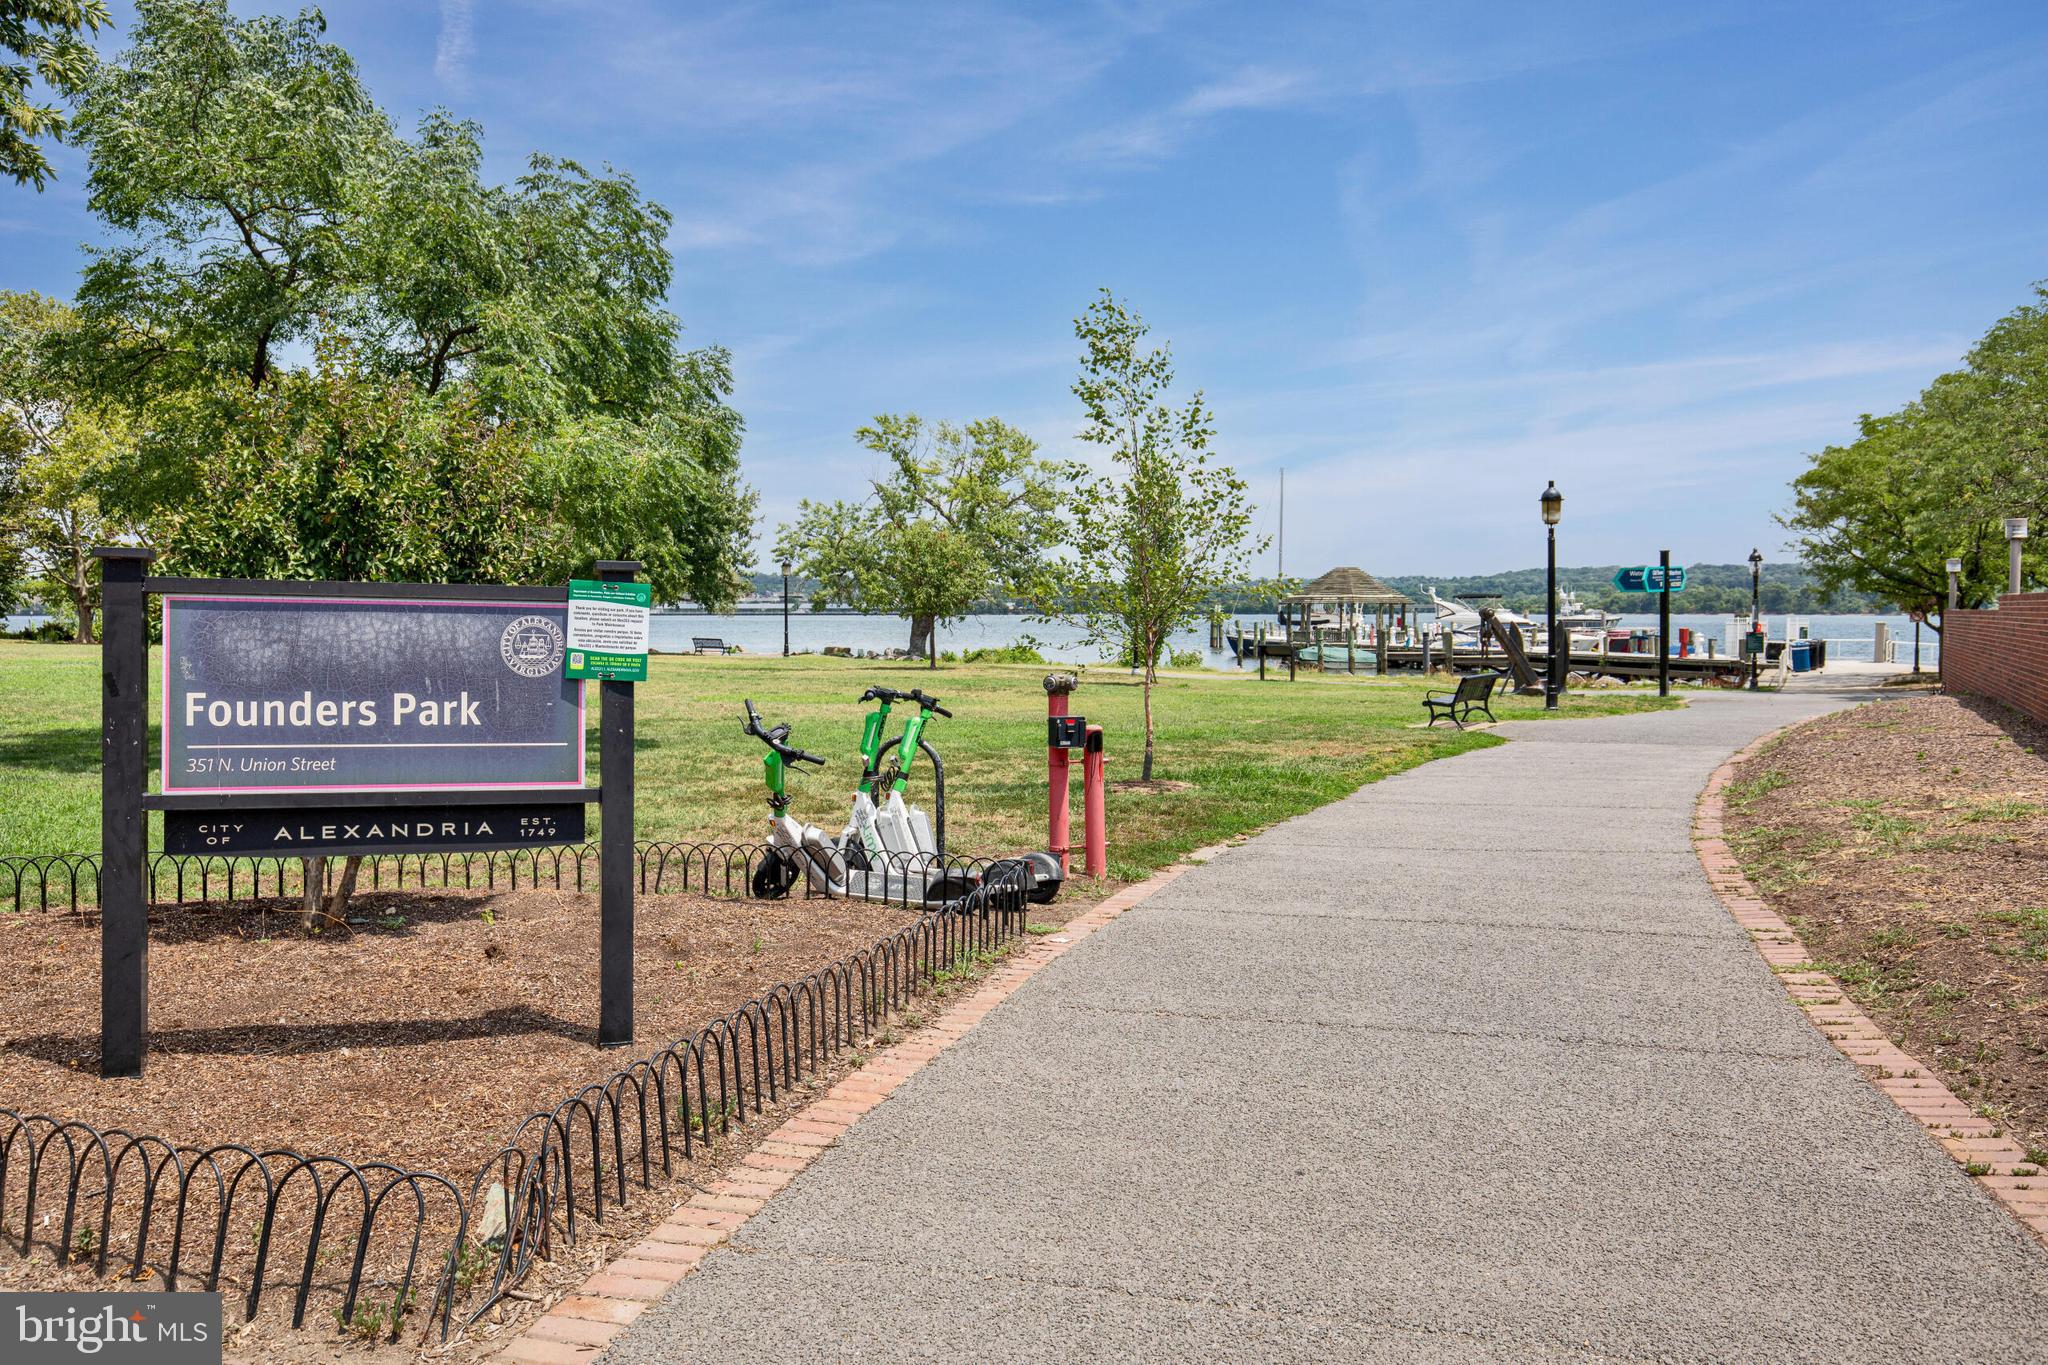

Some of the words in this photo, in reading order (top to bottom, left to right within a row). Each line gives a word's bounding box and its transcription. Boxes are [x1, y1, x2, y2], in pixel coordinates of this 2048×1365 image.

[508, 657, 558, 676] VIRGINIA
[186, 691, 377, 727] Founders
[393, 691, 481, 726] Park
[186, 758, 213, 773] 351
[218, 758, 234, 772] N.
[240, 757, 286, 771] Union
[291, 757, 336, 771] Street
[520, 817, 556, 826] EST.
[198, 824, 244, 833] CITY
[274, 821, 494, 841] ALEXANDRIA
[519, 828, 556, 837] 1749
[206, 837, 231, 845] OF
